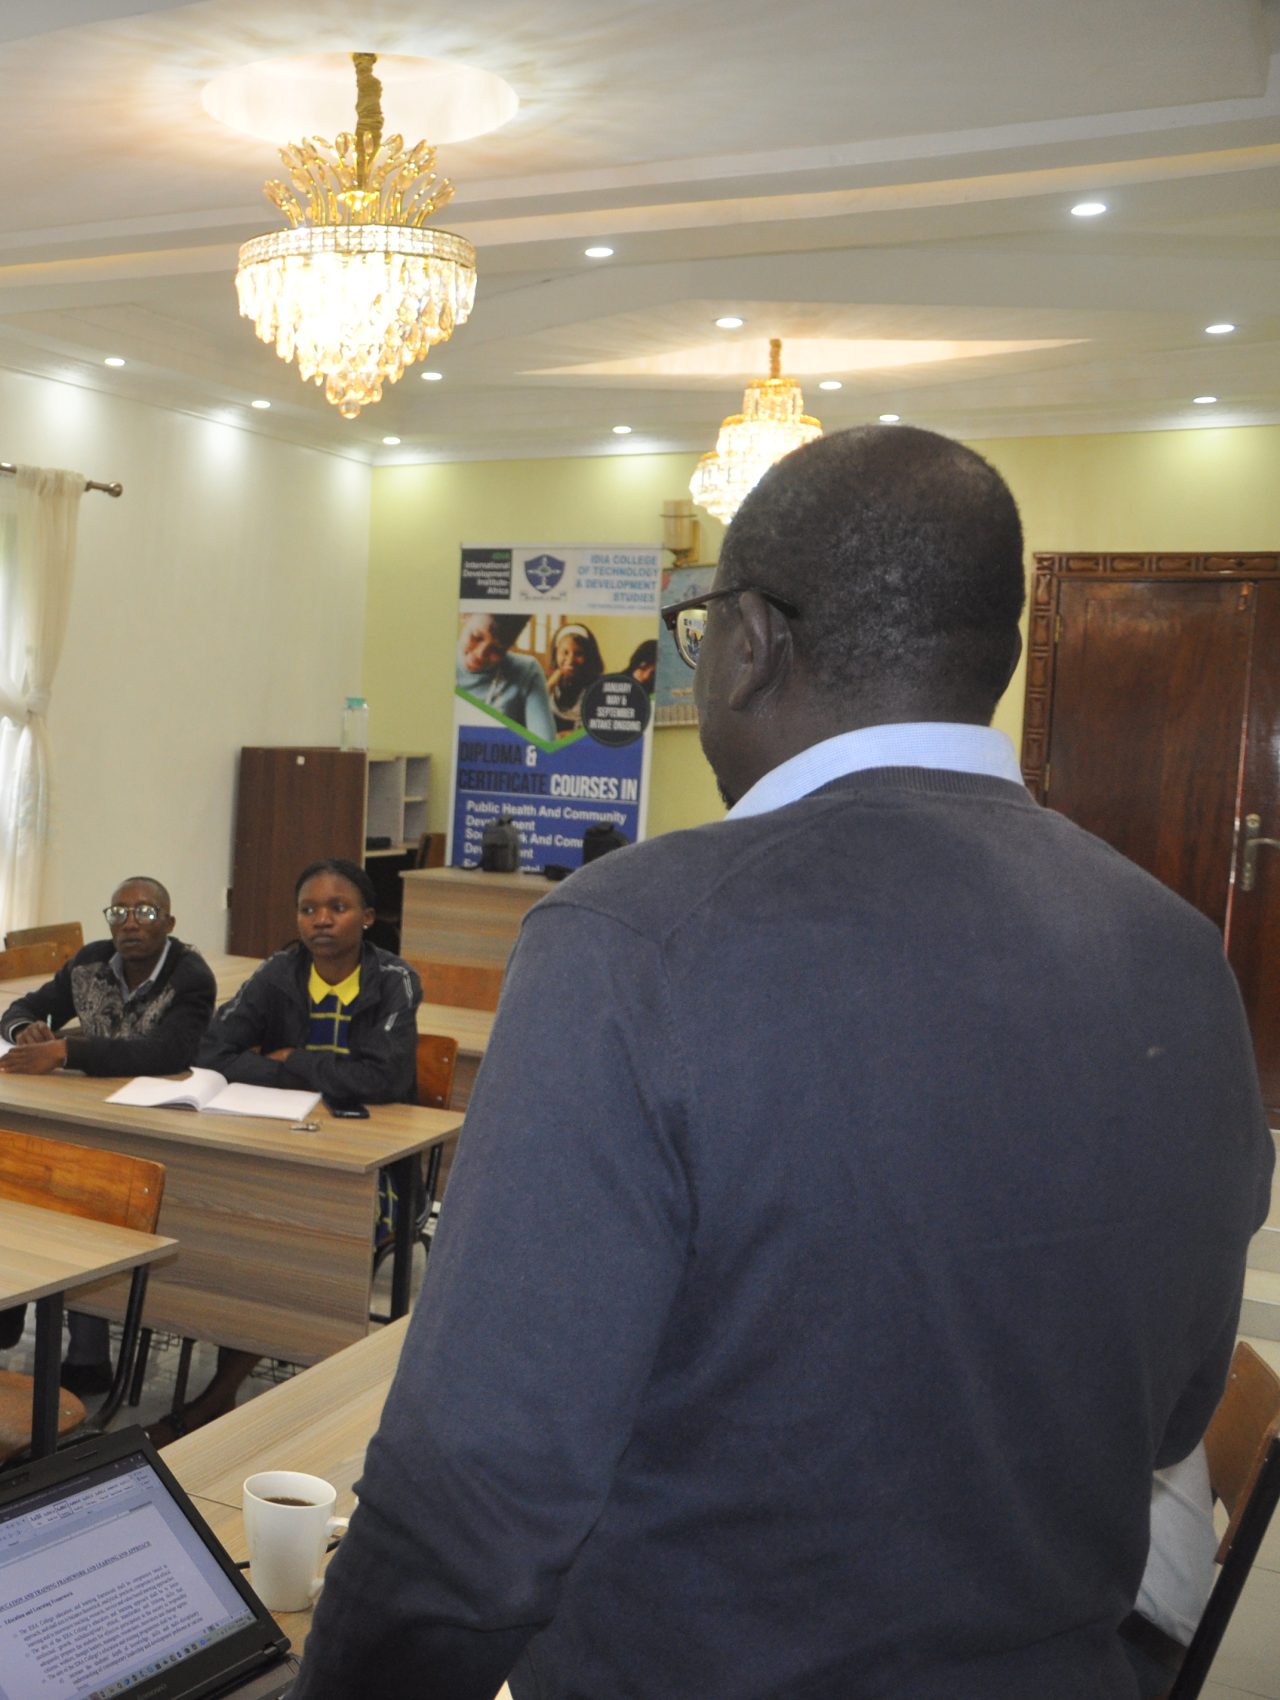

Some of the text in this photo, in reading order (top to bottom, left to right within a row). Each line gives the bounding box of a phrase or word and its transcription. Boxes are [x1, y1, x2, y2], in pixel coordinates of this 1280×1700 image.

[464, 560, 511, 570] International
[613, 554, 657, 565] COLLEGE
[463, 569, 511, 579] Development
[593, 566, 659, 577] TECHNOLOGY
[585, 579, 656, 590] DEVELOPMENT
[613, 591, 656, 602] STUDIES
[602, 682, 632, 694] JANUARY
[596, 706, 636, 719] SEPTEMBER
[459, 741, 538, 767] DIPLOMA &
[458, 768, 638, 801] CERTIFICATE COURSES IN
[466, 800, 628, 826] Public Health And Community
[529, 833, 554, 847] And
